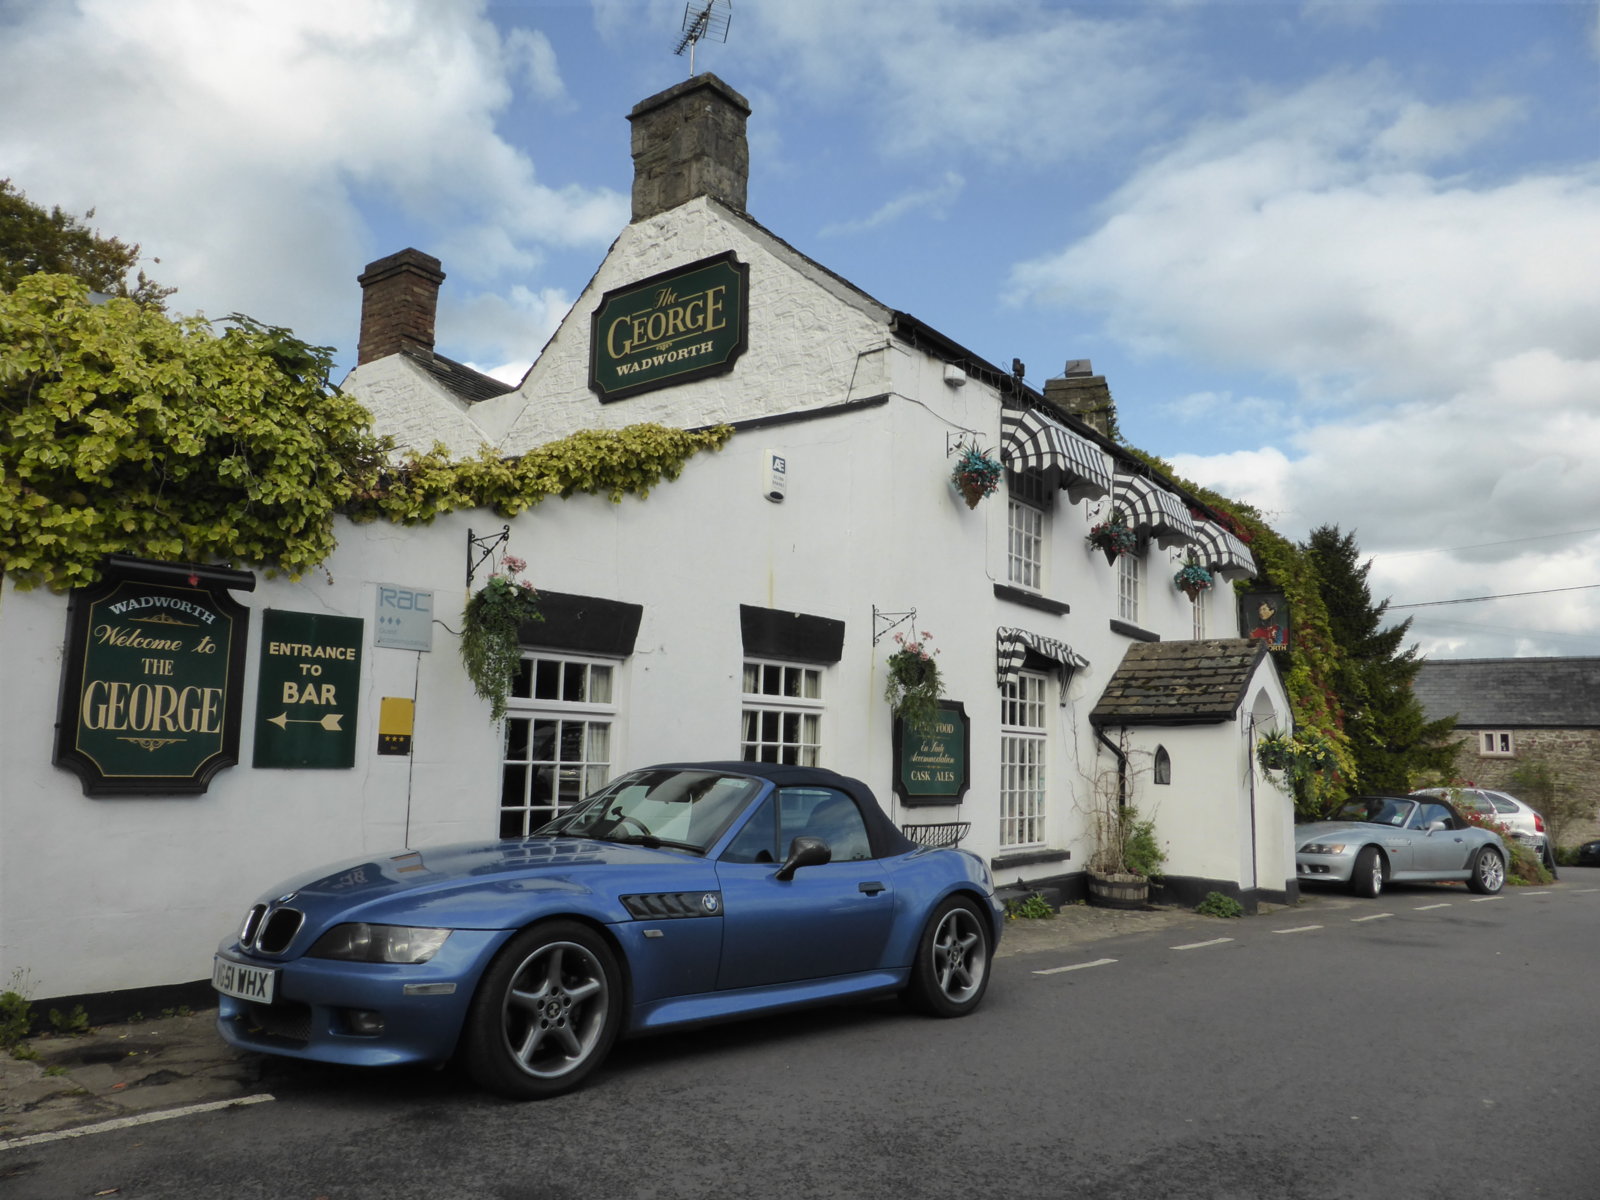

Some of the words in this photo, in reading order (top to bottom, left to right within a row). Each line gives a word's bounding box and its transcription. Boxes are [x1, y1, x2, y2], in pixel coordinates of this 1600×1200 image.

[652, 287, 679, 309] The
[607, 285, 726, 359] GEORGE
[616, 341, 714, 376] WADWORTH
[109, 596, 216, 625] WADWORTH
[94, 624, 182, 651] Welcome
[191, 635, 216, 654] to
[269, 642, 356, 660] ENTRANCE
[142, 658, 174, 676] THE
[299, 664, 322, 676] TO
[282, 682, 337, 705] BAR
[83, 680, 222, 733] GEORGE
[936, 723, 954, 734] FOOD
[911, 771, 931, 781] CASK
[935, 771, 954, 782] ALES
[237, 968, 268, 998] WHX
